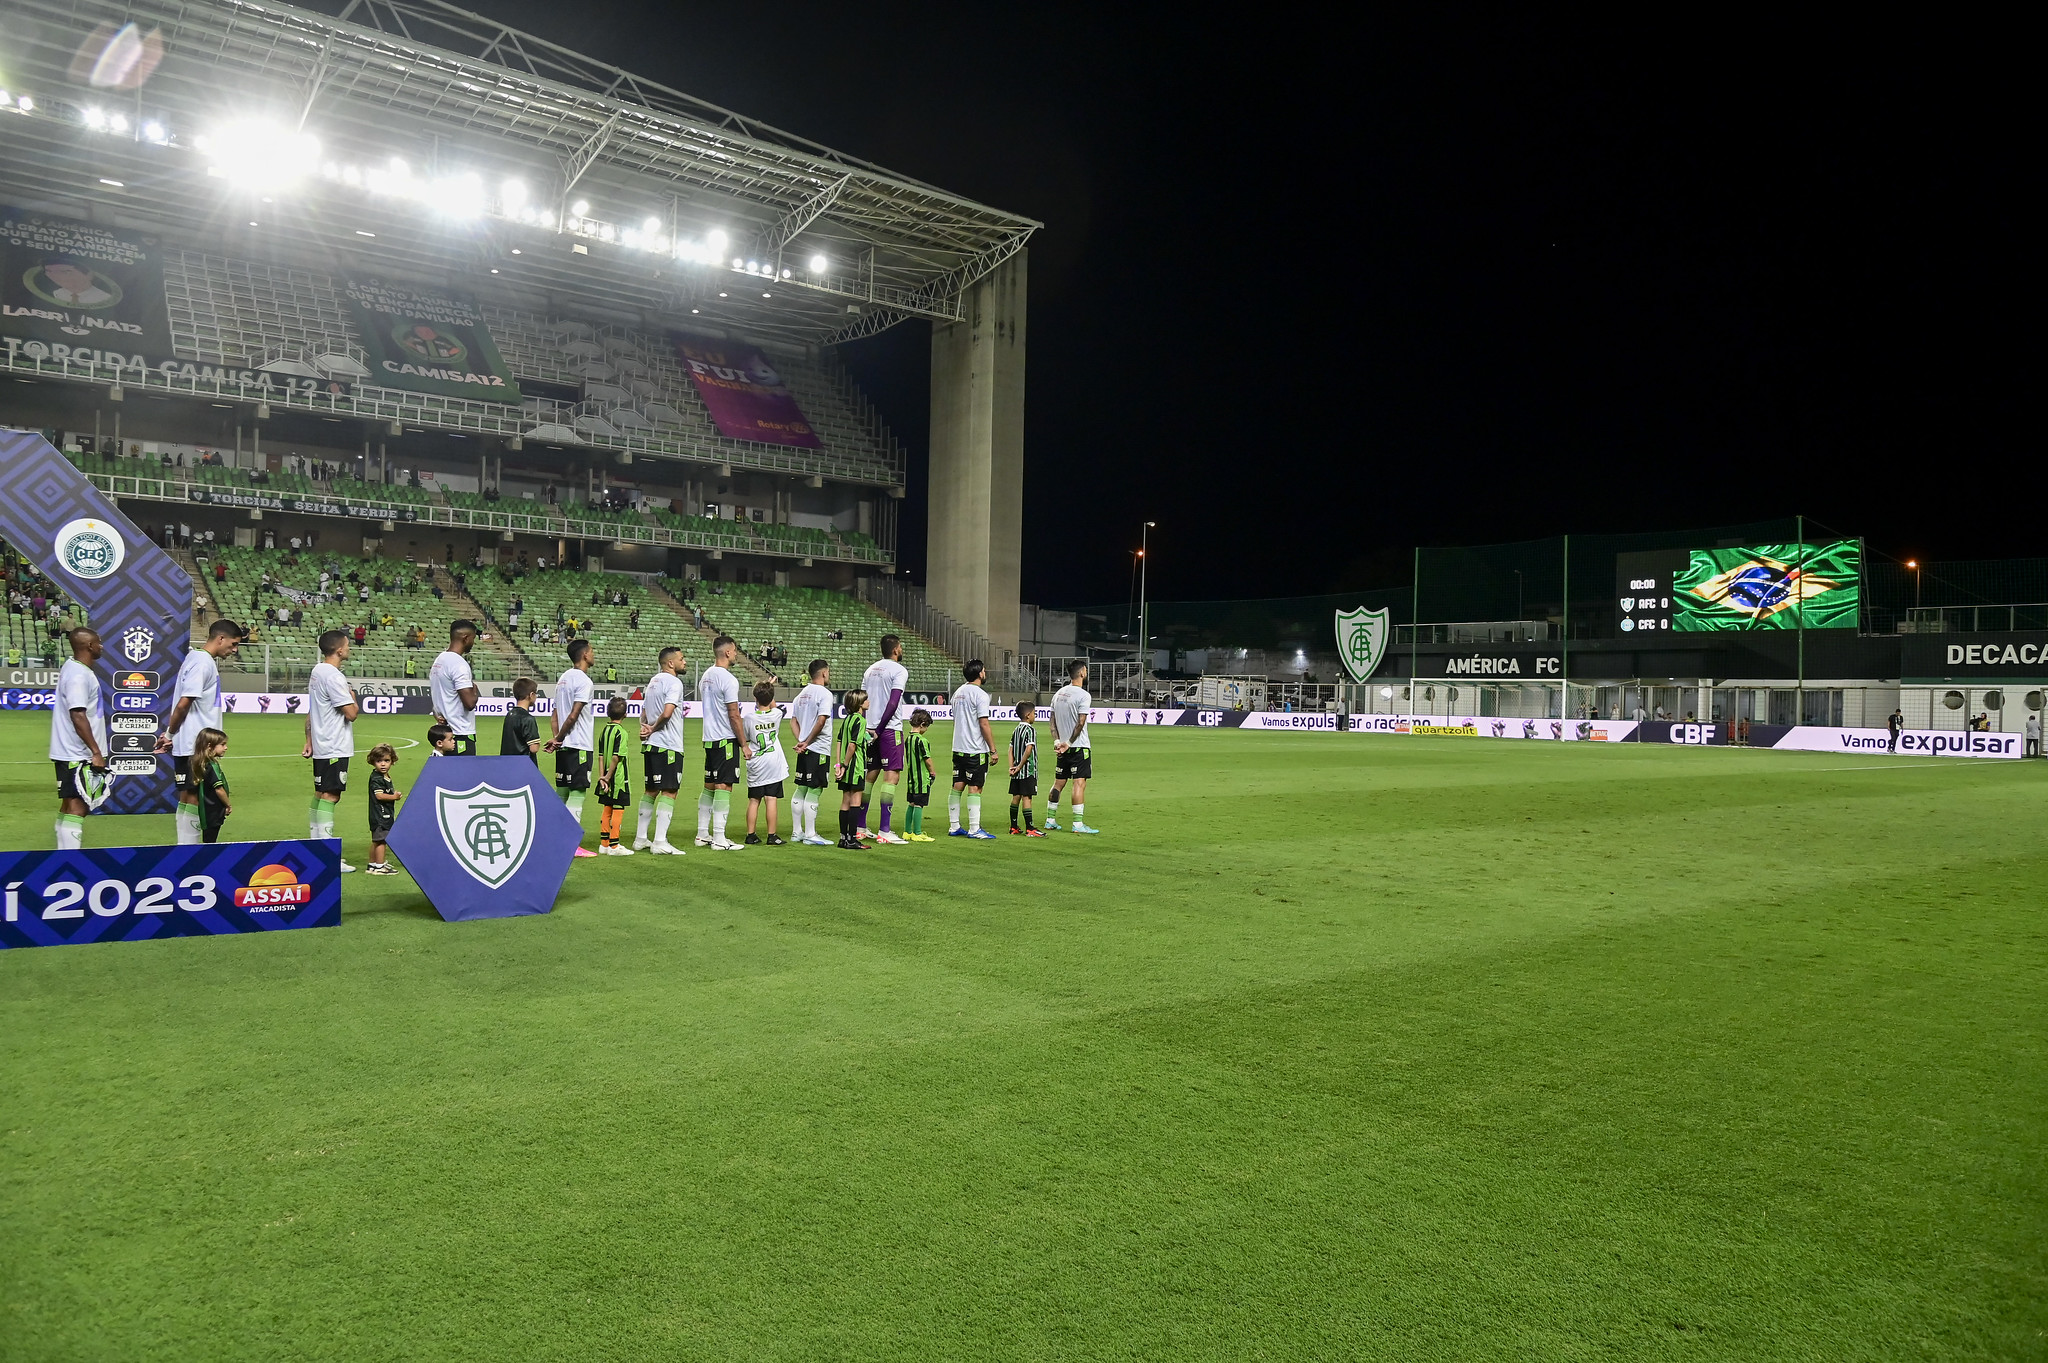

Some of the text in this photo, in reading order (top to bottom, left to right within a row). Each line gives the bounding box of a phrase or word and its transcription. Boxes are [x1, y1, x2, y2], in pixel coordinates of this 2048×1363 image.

[18, 223, 69, 238] GRATO
[26, 240, 55, 252] SEU
[59, 247, 135, 266] PAVILHÃO
[34, 233, 147, 261] ENGRANDECEM
[345, 289, 375, 303] QUE
[375, 303, 401, 316] SEU
[3, 336, 318, 399] TORCIDA CAMISA 12
[687, 359, 751, 384] FUI
[757, 419, 790, 432] Rotary
[210, 493, 399, 520] TORCIDA SEITA VERDE
[77, 549, 105, 561] CFC
[1630, 579, 1656, 590] 00:00
[1638, 598, 1669, 609] AFC 0
[1638, 618, 1668, 630] CFC 0
[1445, 653, 1560, 675] AMÉRICA FC
[11, 670, 60, 686] CLUB
[18, 693, 56, 705] 202
[120, 696, 152, 709] CBF
[362, 696, 405, 714] CBF
[1197, 711, 1224, 727] CBF
[1262, 716, 1290, 727] Vamos
[1365, 720, 1371, 730] o
[1414, 727, 1475, 735] quartzolit
[1670, 723, 1716, 745] CBF
[1901, 731, 2016, 757] expulsar
[41, 874, 218, 921] 2023
[249, 904, 297, 914] ATACADISTA
